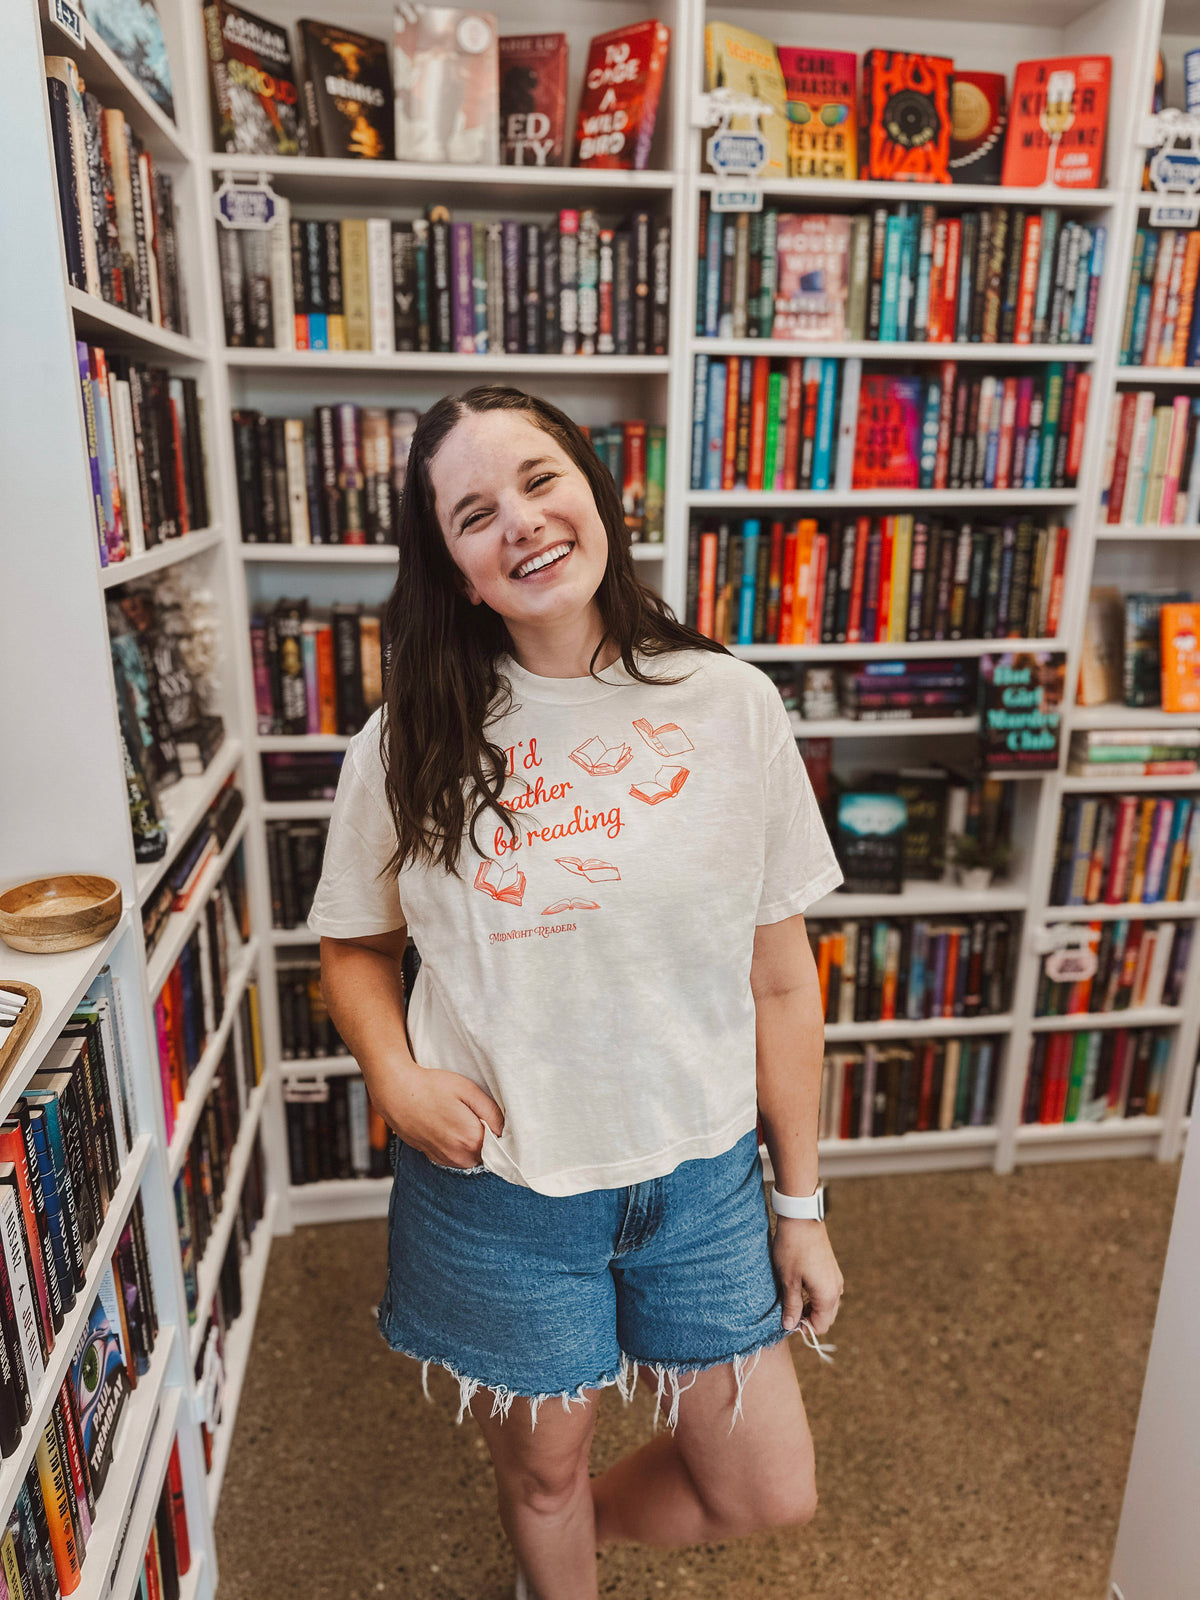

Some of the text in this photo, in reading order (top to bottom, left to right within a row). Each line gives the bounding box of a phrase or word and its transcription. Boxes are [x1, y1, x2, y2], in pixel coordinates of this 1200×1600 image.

[587, 58, 640, 90] CAGE
[605, 43, 631, 66] TO
[871, 49, 954, 97] HOT
[599, 88, 617, 112] A
[582, 110, 628, 135] WILD
[579, 132, 625, 160] BIRD
[871, 140, 954, 184] WAX
[502, 738, 543, 777] I'd
[494, 805, 626, 856] be reading
[26, 1123, 39, 1173] ISABEL
[44, 1230, 61, 1315] SUBLIMATION
[23, 1305, 33, 1338] JOE
[28, 1331, 38, 1371] HILL
[90, 1373, 124, 1471] TREMBLAY
[92, 1381, 112, 1431] PAUL
[50, 1454, 60, 1473] YOU
